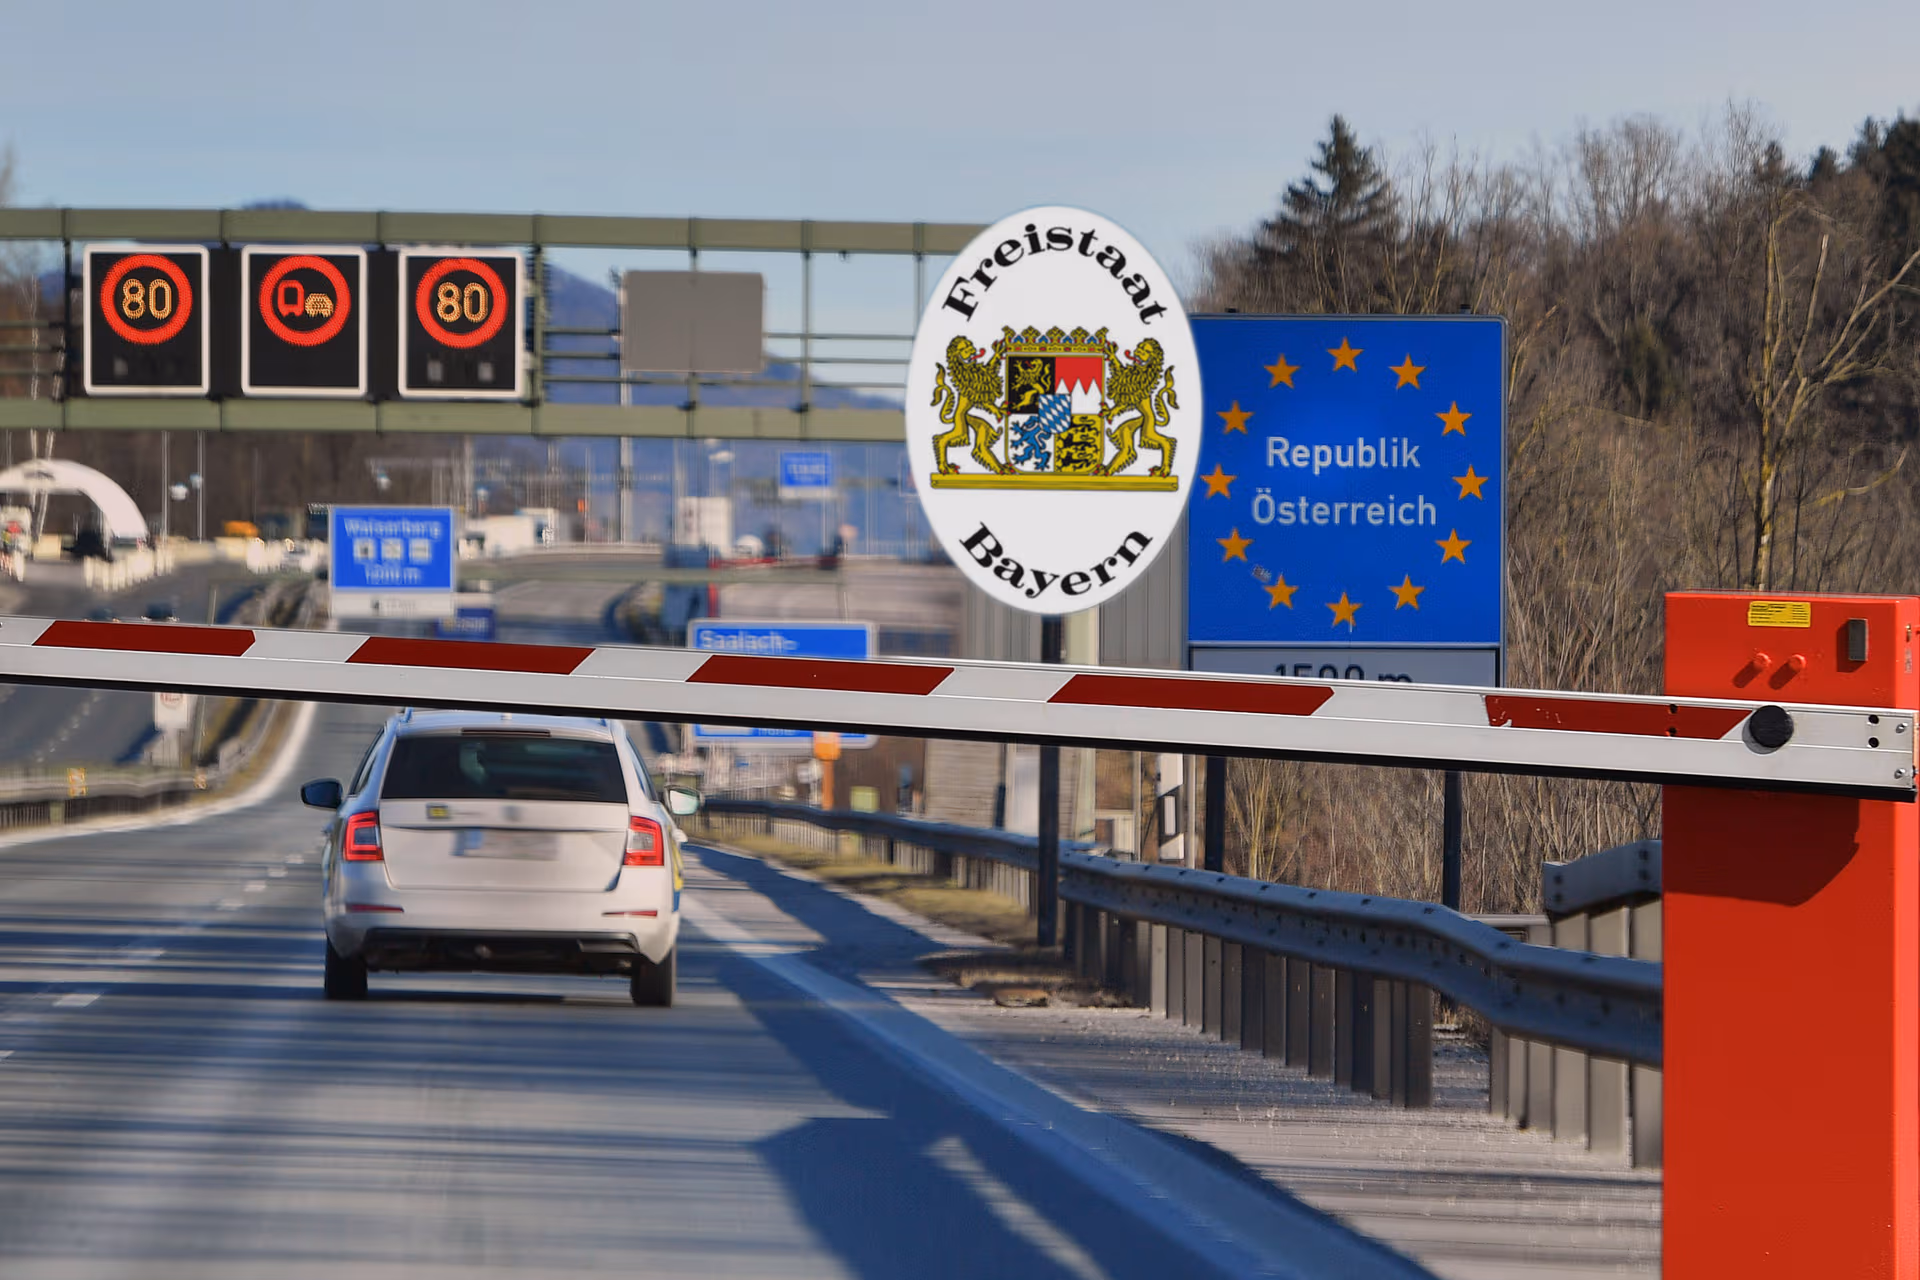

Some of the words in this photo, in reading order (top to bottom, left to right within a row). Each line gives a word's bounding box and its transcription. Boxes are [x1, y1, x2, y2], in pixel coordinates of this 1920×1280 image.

[941, 223, 1168, 325] Freistaat
[122, 278, 172, 320] 80
[436, 281, 488, 323] 80
[1266, 436, 1420, 475] Republik
[1252, 487, 1437, 525] Österreich
[958, 521, 1153, 599] Bayern
